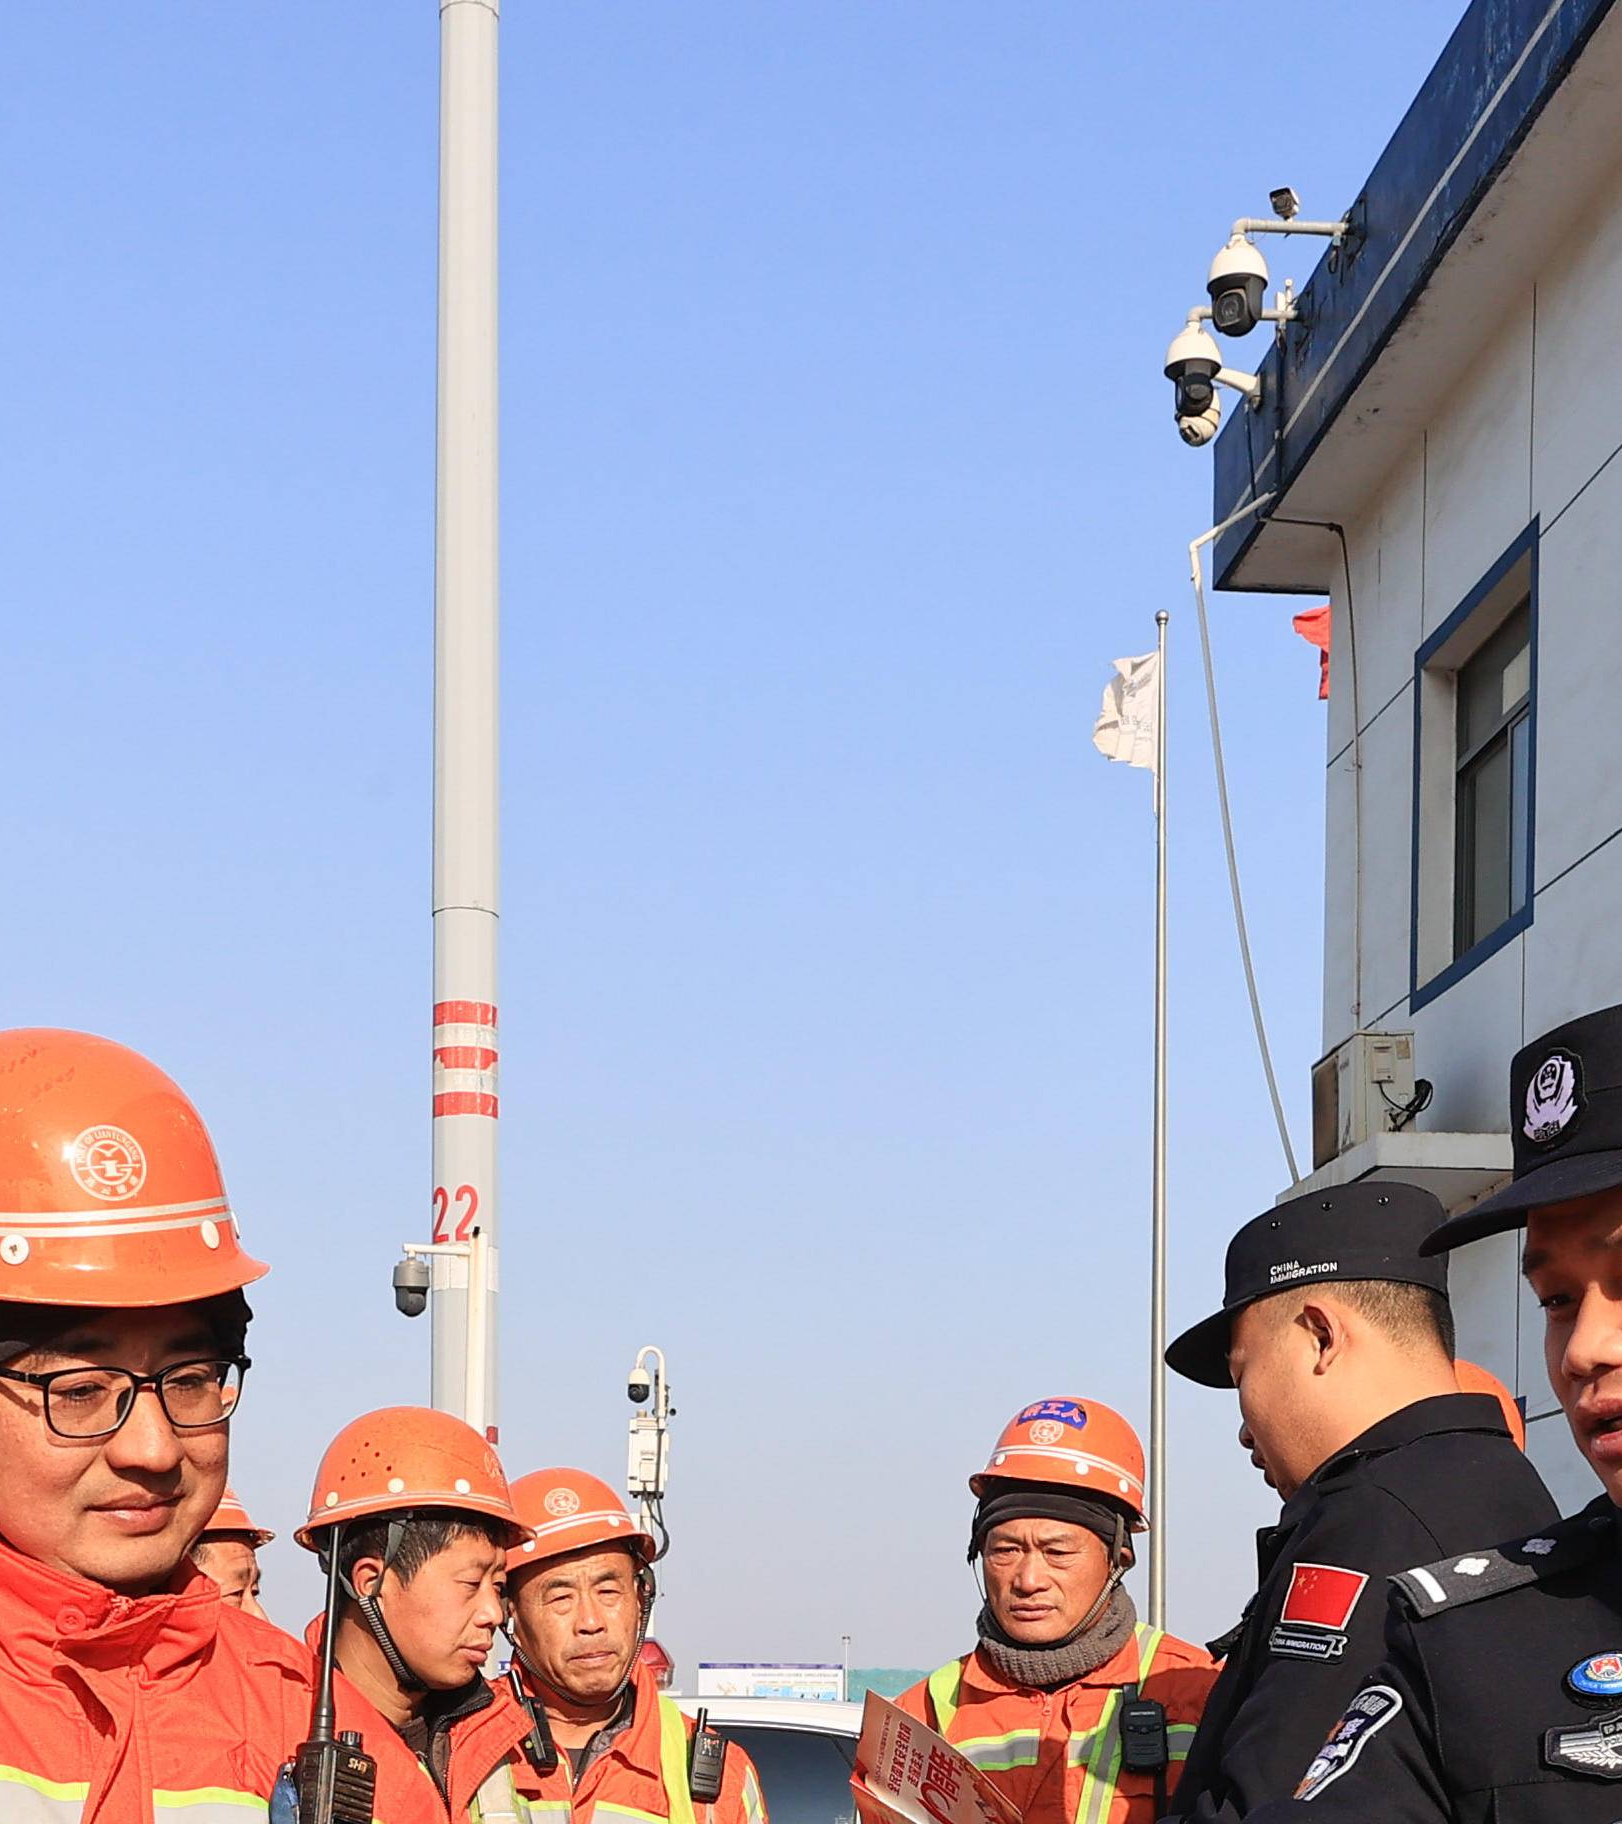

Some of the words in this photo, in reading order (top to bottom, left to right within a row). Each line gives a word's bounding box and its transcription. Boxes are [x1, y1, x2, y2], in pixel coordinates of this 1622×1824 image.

[432, 1184, 479, 1243] 22
[1270, 1260, 1300, 1275] CHINA
[1270, 1262, 1338, 1284] IMMIGRATION
